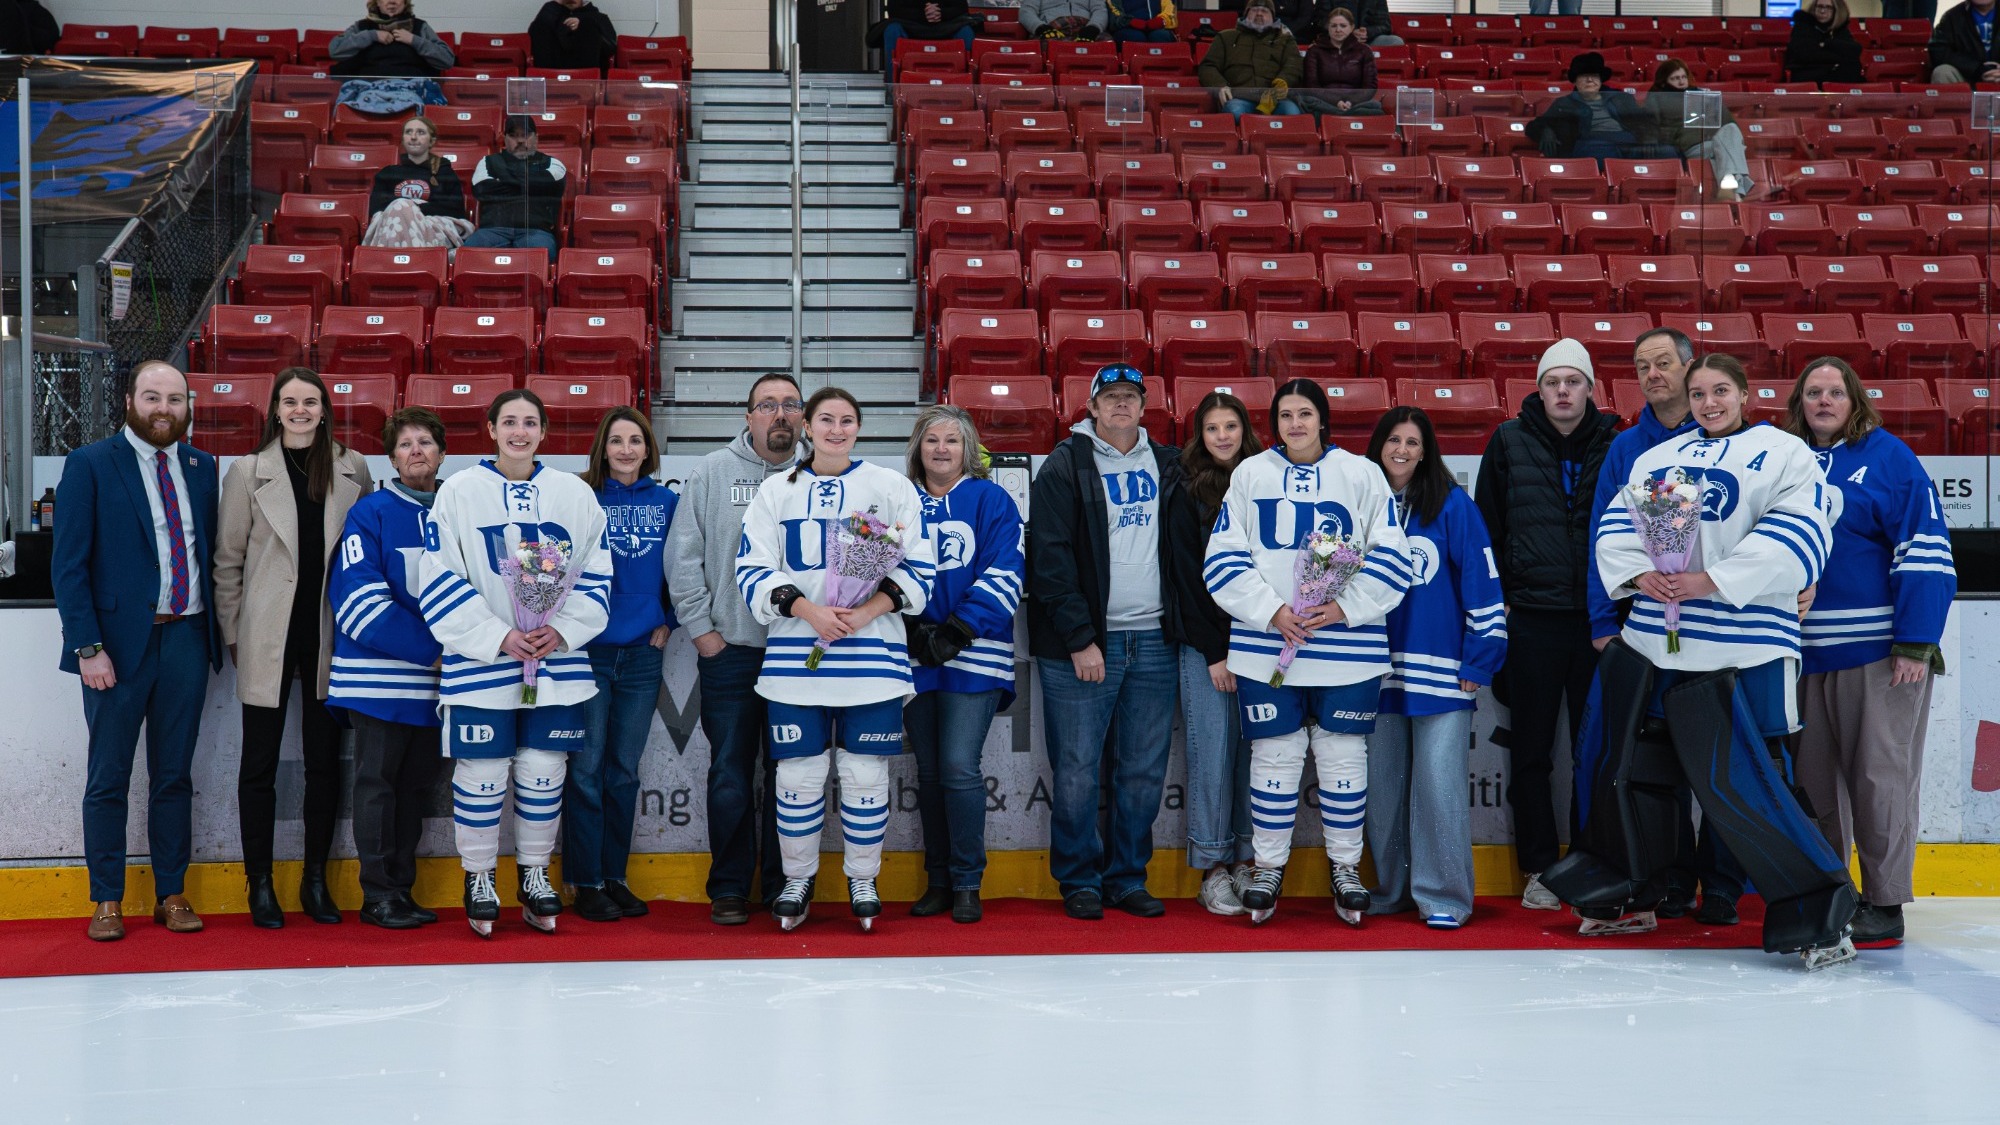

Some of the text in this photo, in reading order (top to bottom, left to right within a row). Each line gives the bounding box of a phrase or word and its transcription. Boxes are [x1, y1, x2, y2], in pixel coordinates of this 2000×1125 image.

[1747, 450, 1768, 472] A
[1848, 466, 1868, 484] A
[1101, 469, 1157, 506] UD
[610, 525, 660, 533] OCKEY
[342, 534, 365, 571] 18
[1245, 702, 1278, 723] UD
[457, 724, 495, 744] UD
[771, 723, 802, 744] UD
